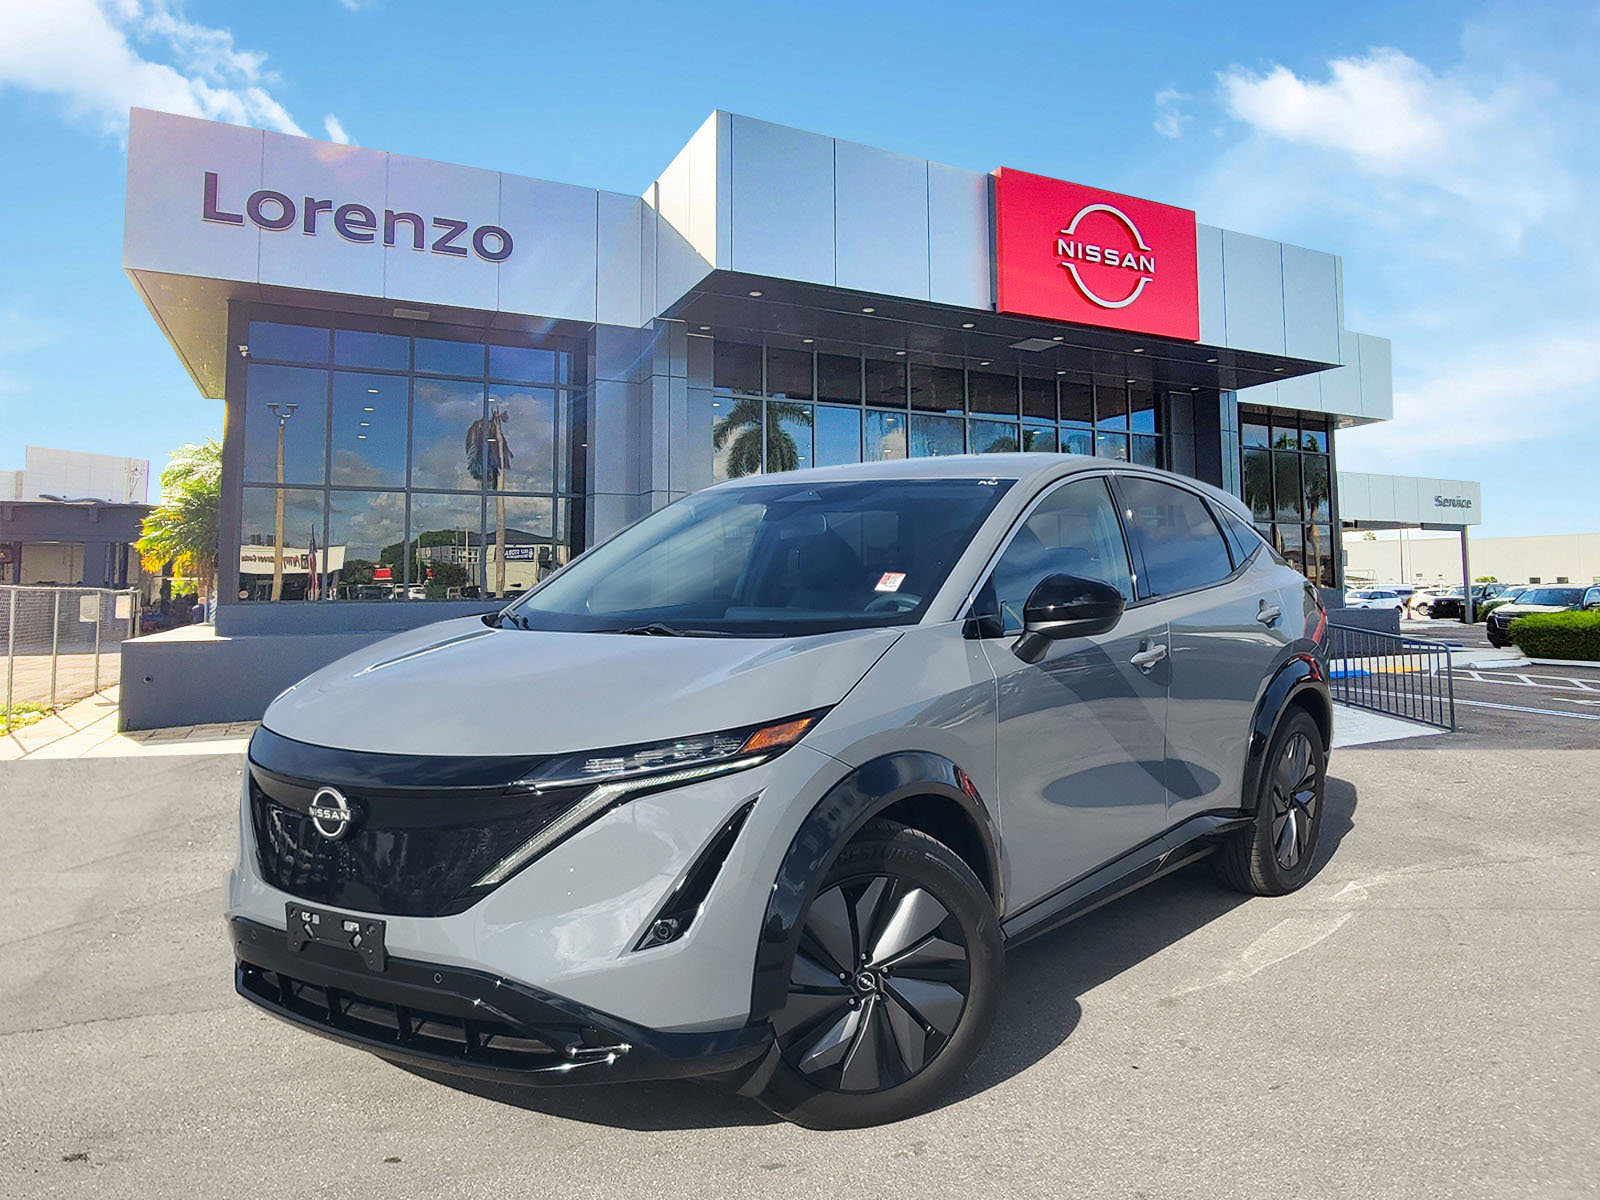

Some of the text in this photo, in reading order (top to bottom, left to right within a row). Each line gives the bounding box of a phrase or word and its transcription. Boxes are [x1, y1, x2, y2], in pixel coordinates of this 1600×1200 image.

[202, 171, 514, 262] Lorenzo
[1057, 238, 1155, 273] NISSAN
[1434, 495, 1472, 509] Service
[309, 806, 350, 821] NISSAN
